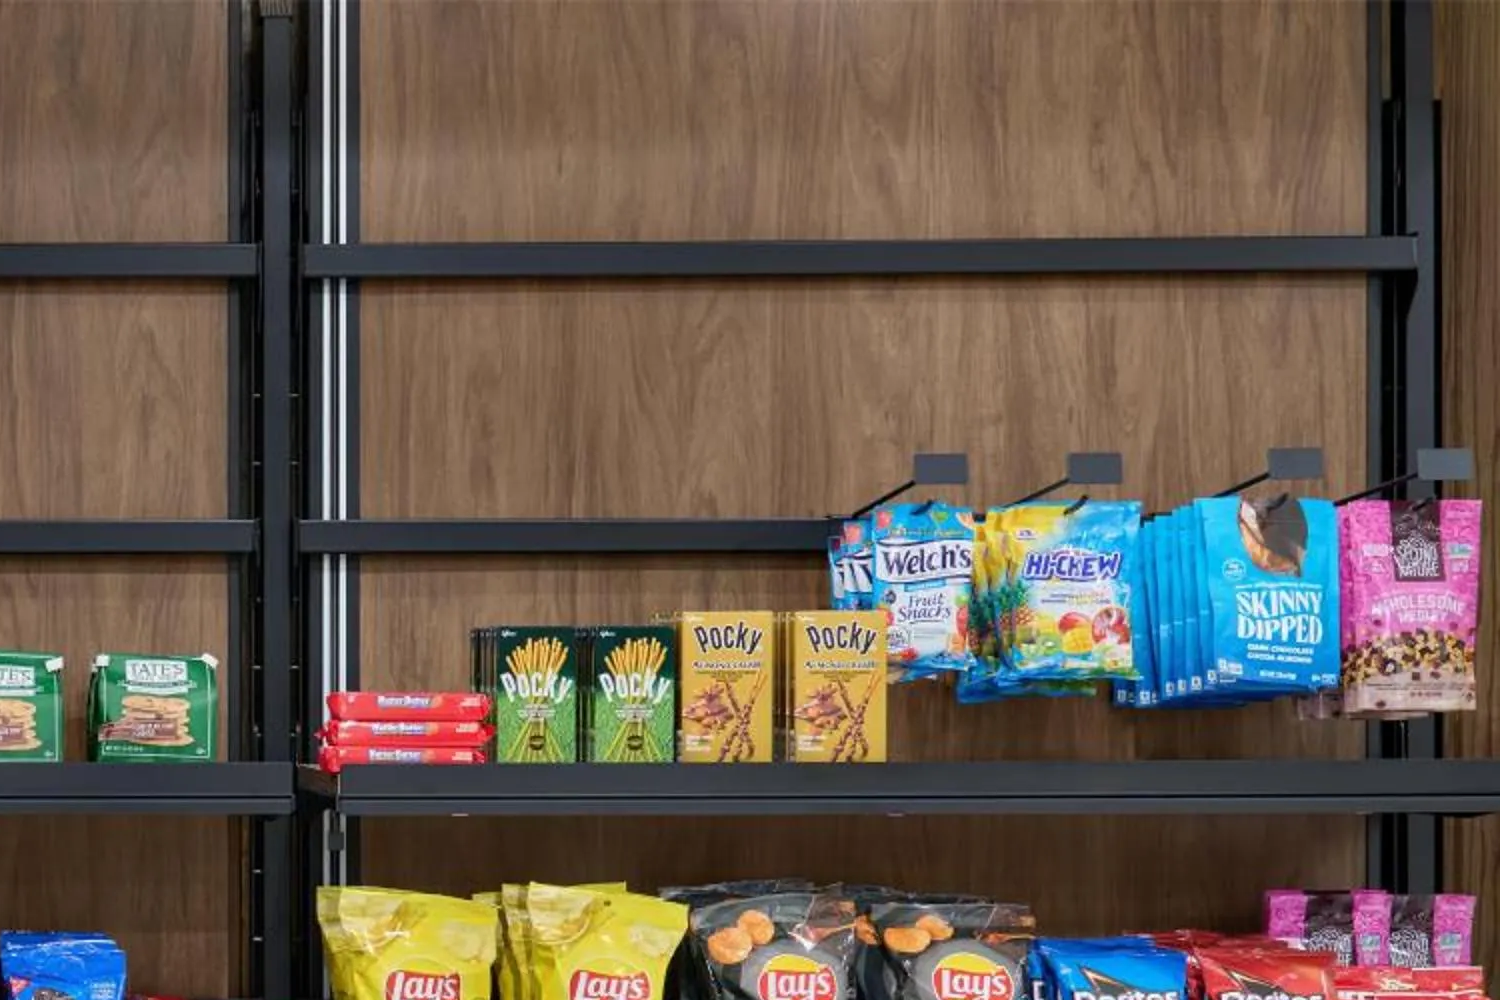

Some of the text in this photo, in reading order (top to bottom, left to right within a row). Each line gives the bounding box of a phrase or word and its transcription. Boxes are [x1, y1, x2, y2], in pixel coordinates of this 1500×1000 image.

[883, 544, 971, 576] Welch's
[1025, 552, 1122, 580] HI-CHEW
[898, 604, 951, 622] Snacks
[1236, 589, 1323, 618] SKINNY
[1237, 615, 1323, 645] DIPPED
